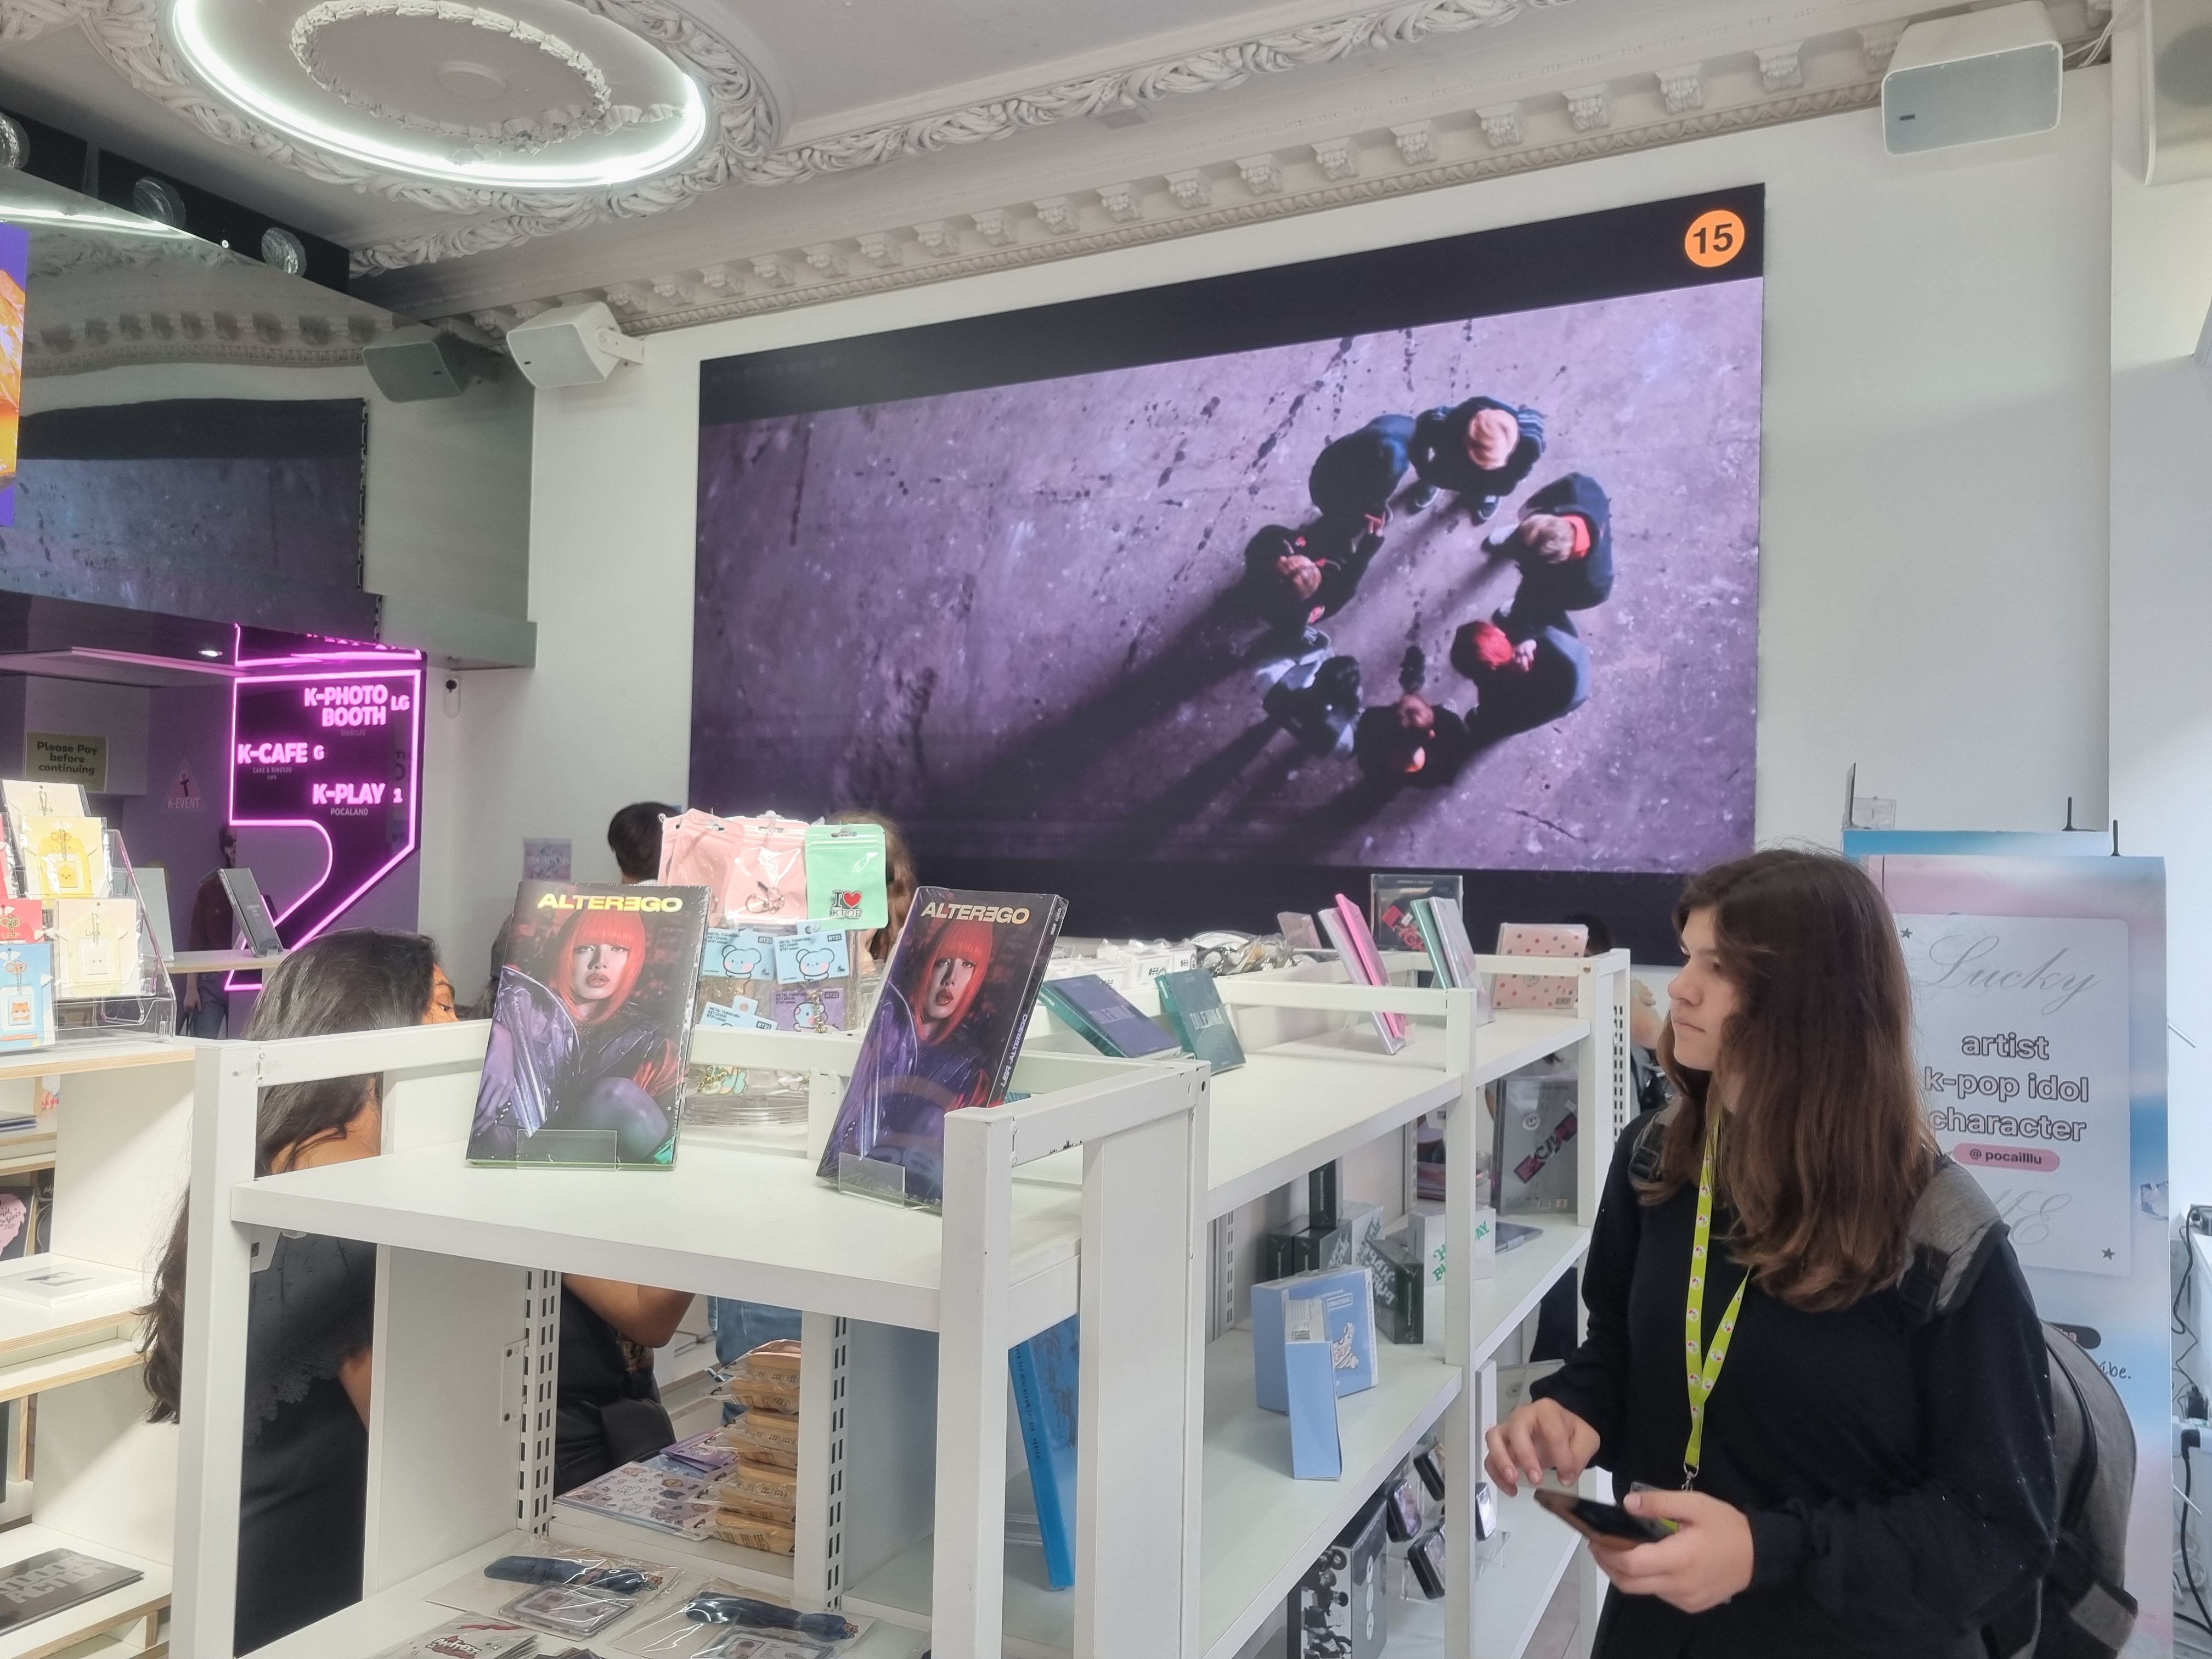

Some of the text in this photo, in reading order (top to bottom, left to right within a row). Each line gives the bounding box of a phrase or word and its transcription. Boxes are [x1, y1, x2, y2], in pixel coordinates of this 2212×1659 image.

[1693, 223, 1733, 255] 15
[304, 684, 410, 710] K-PHOTO LG
[322, 706, 387, 726] BOOTH
[37, 741, 98, 757] Please Pay
[49, 753, 85, 764] before
[237, 742, 325, 764] K-CAFE G
[38, 763, 95, 776] continuing
[167, 797, 200, 809] K-EVENT
[313, 783, 403, 805] K-PLAY 1
[330, 808, 368, 816] POCALAND
[832, 909, 862, 918] KPOP
[1917, 934, 2101, 1015] Lucky
[757, 1022, 771, 1030] BT21
[1961, 1032, 2050, 1060] artist
[1924, 1066, 2089, 1102] k-pop idol
[1929, 1106, 2087, 1142] character
[1970, 1148, 1982, 1160] @
